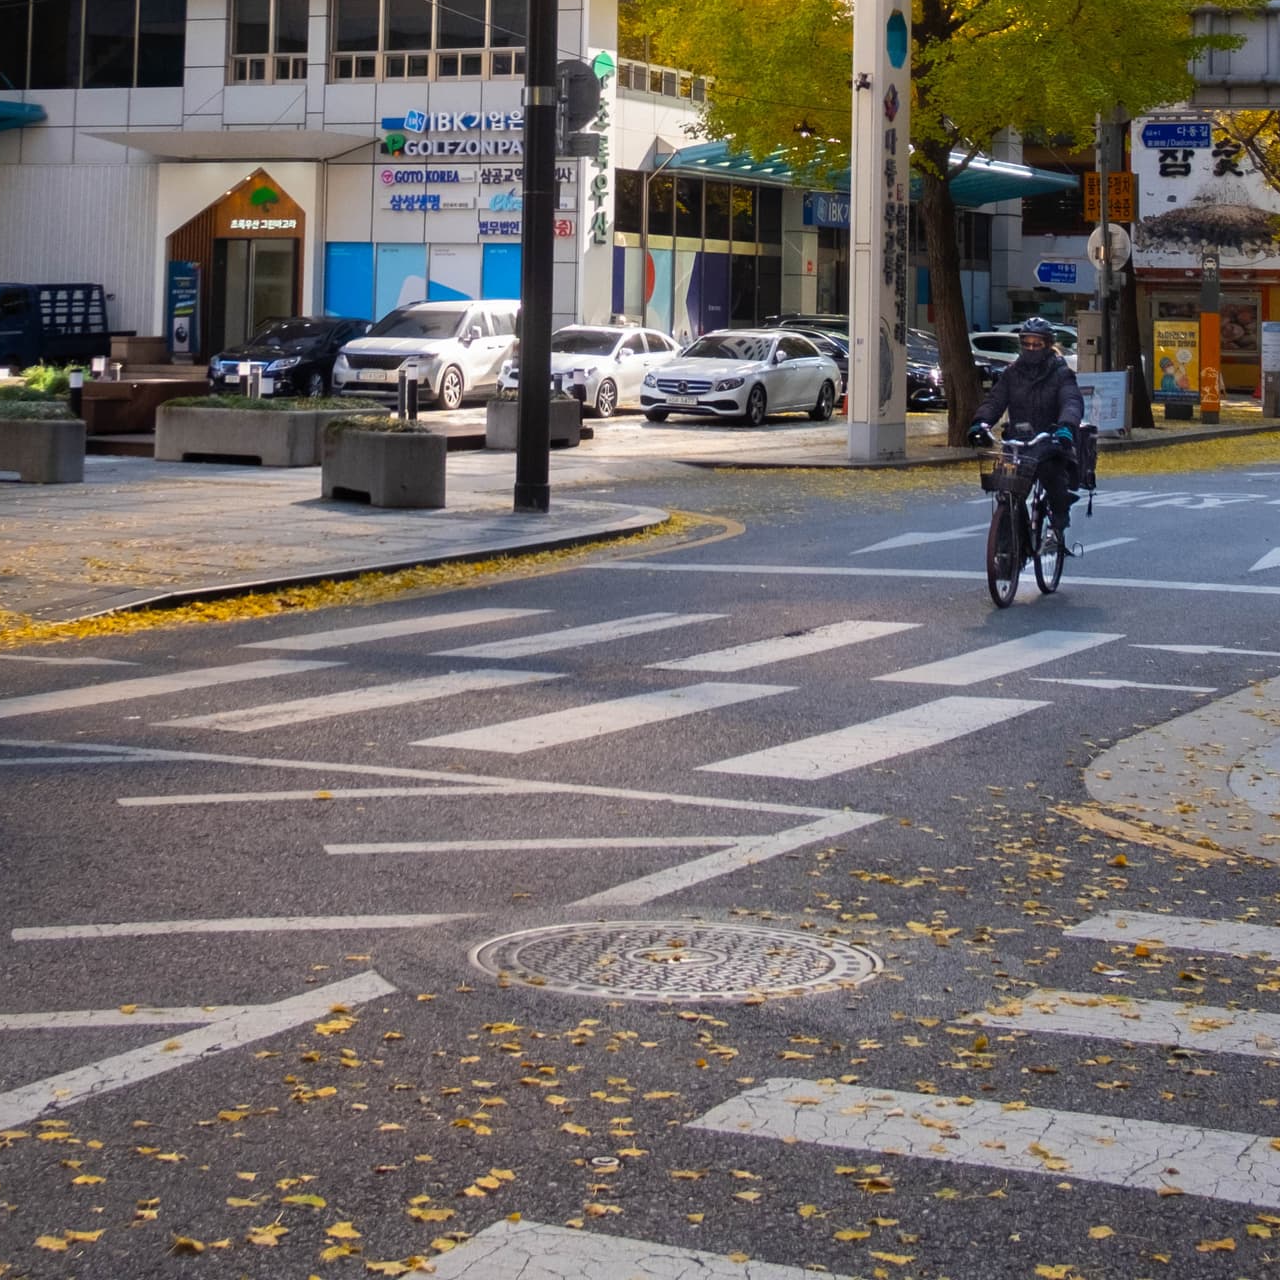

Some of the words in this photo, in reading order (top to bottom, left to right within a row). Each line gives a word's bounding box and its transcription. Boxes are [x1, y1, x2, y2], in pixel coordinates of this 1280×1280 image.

[1176, 125, 1208, 137] 다동길
[404, 139, 495, 157] GOLFZON
[394, 170, 423, 184] GOTO
[425, 170, 460, 184] KOREA
[390, 194, 441, 212] 삼성생명
[478, 220, 520, 235] 법무법인
[553, 219, 574, 237] 증)
